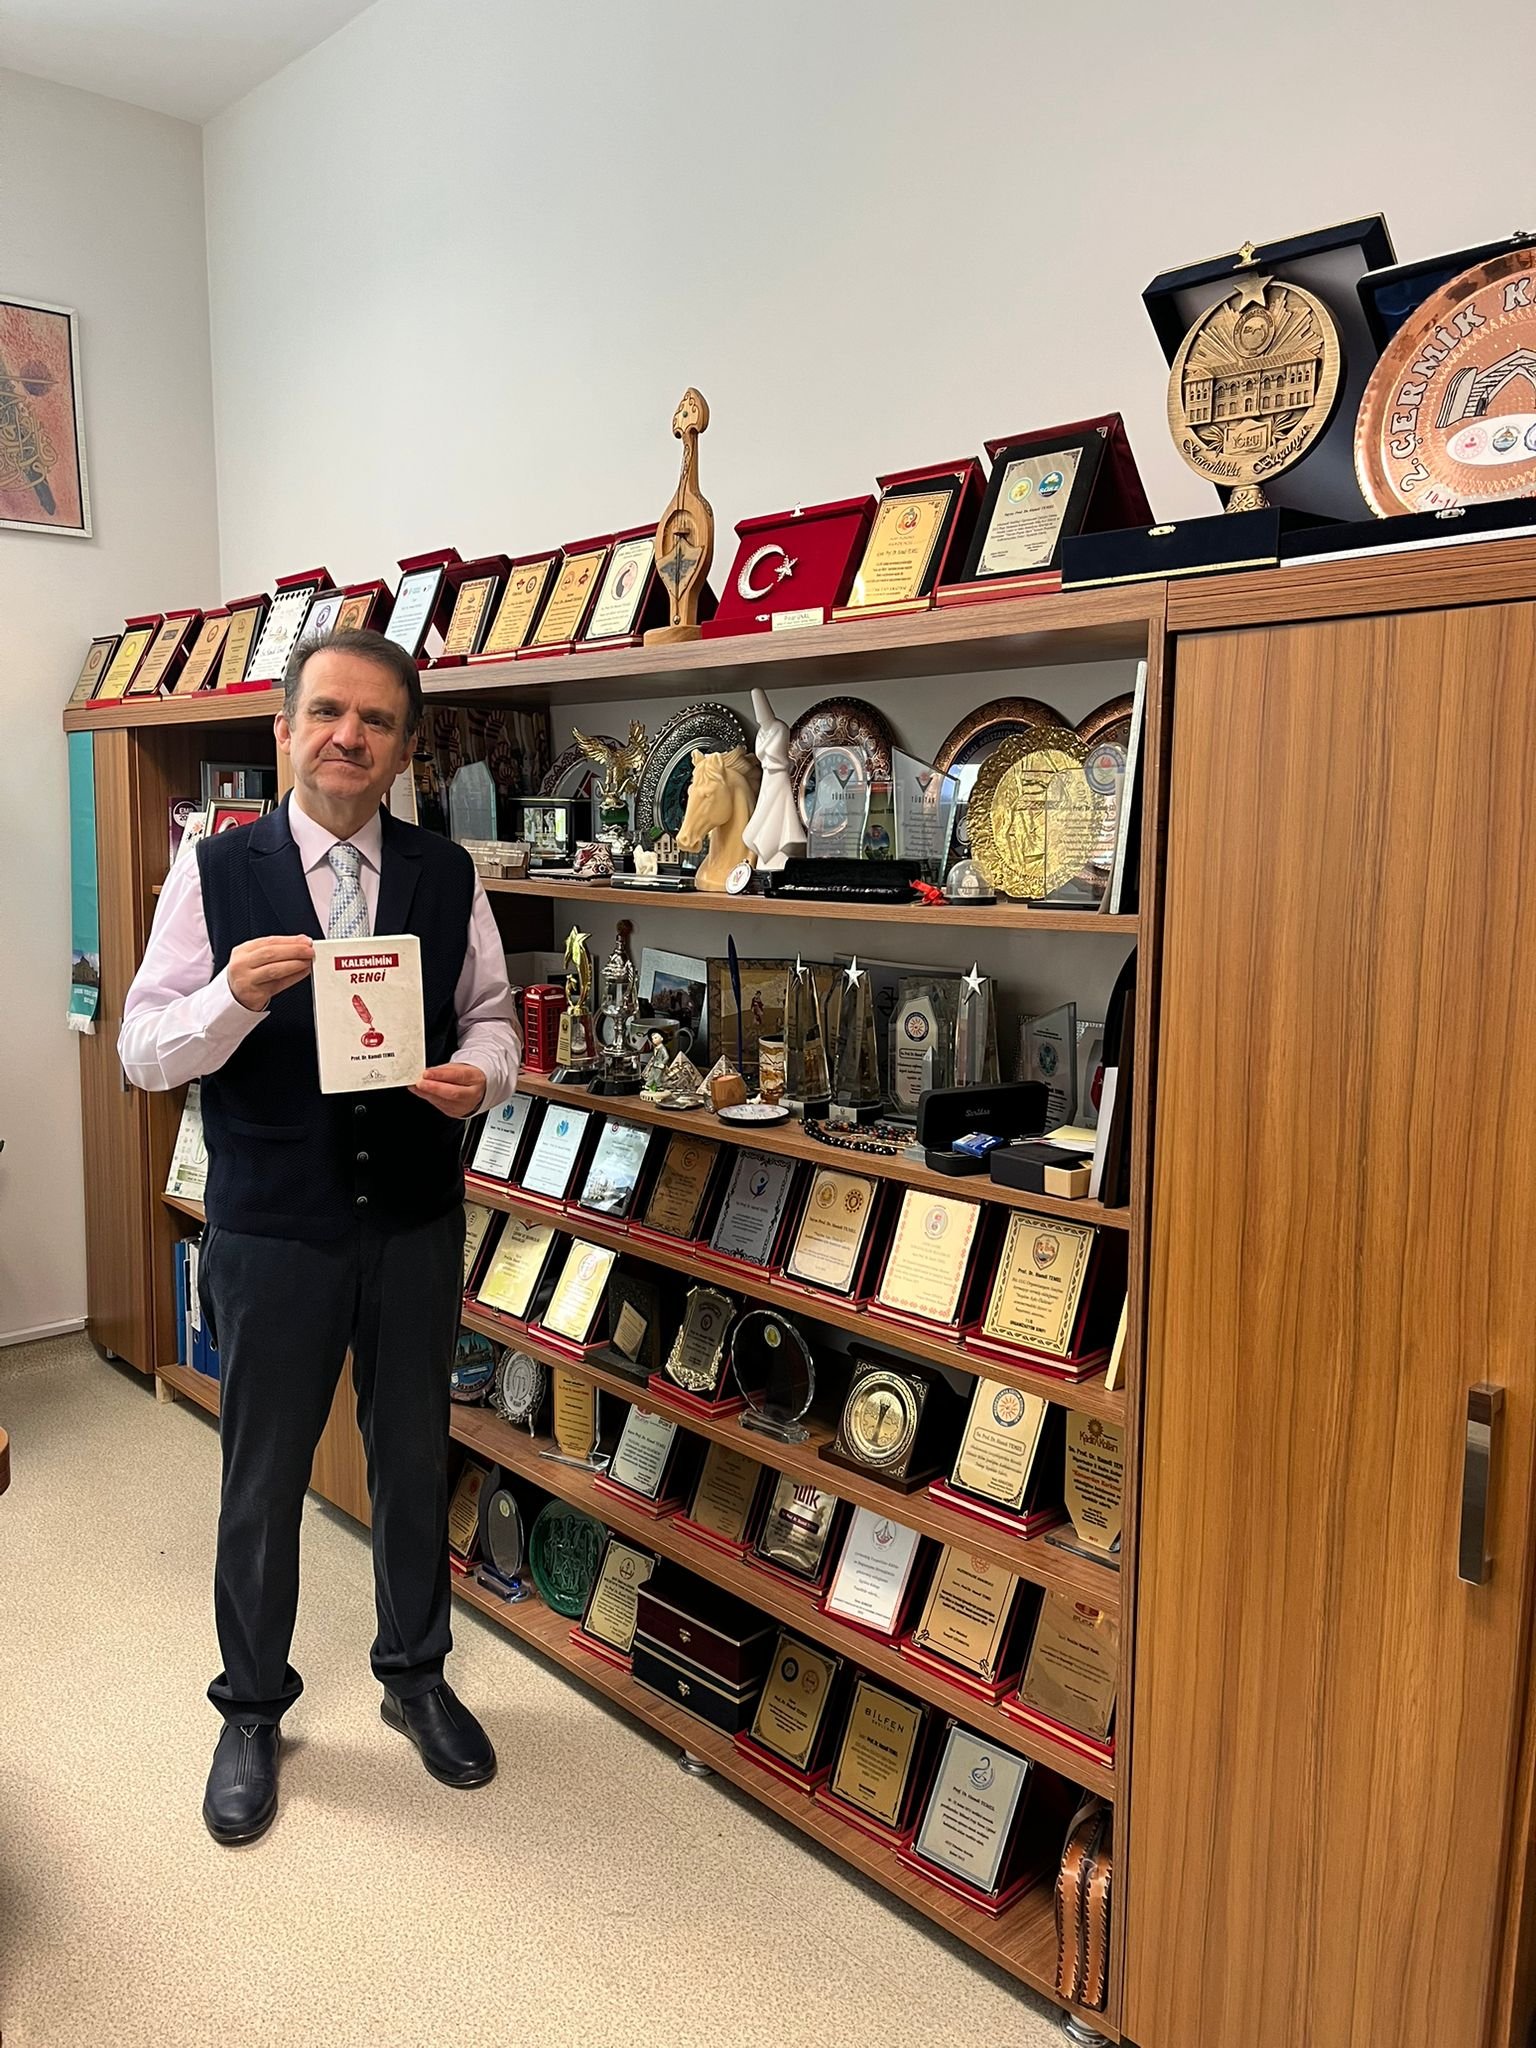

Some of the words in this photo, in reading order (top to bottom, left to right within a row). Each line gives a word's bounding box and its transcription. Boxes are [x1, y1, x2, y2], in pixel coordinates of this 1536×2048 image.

[341, 957, 392, 968] KALEMİMİN
[350, 969, 386, 984] RENGİ
[865, 1707, 905, 1733] BİLFEN
